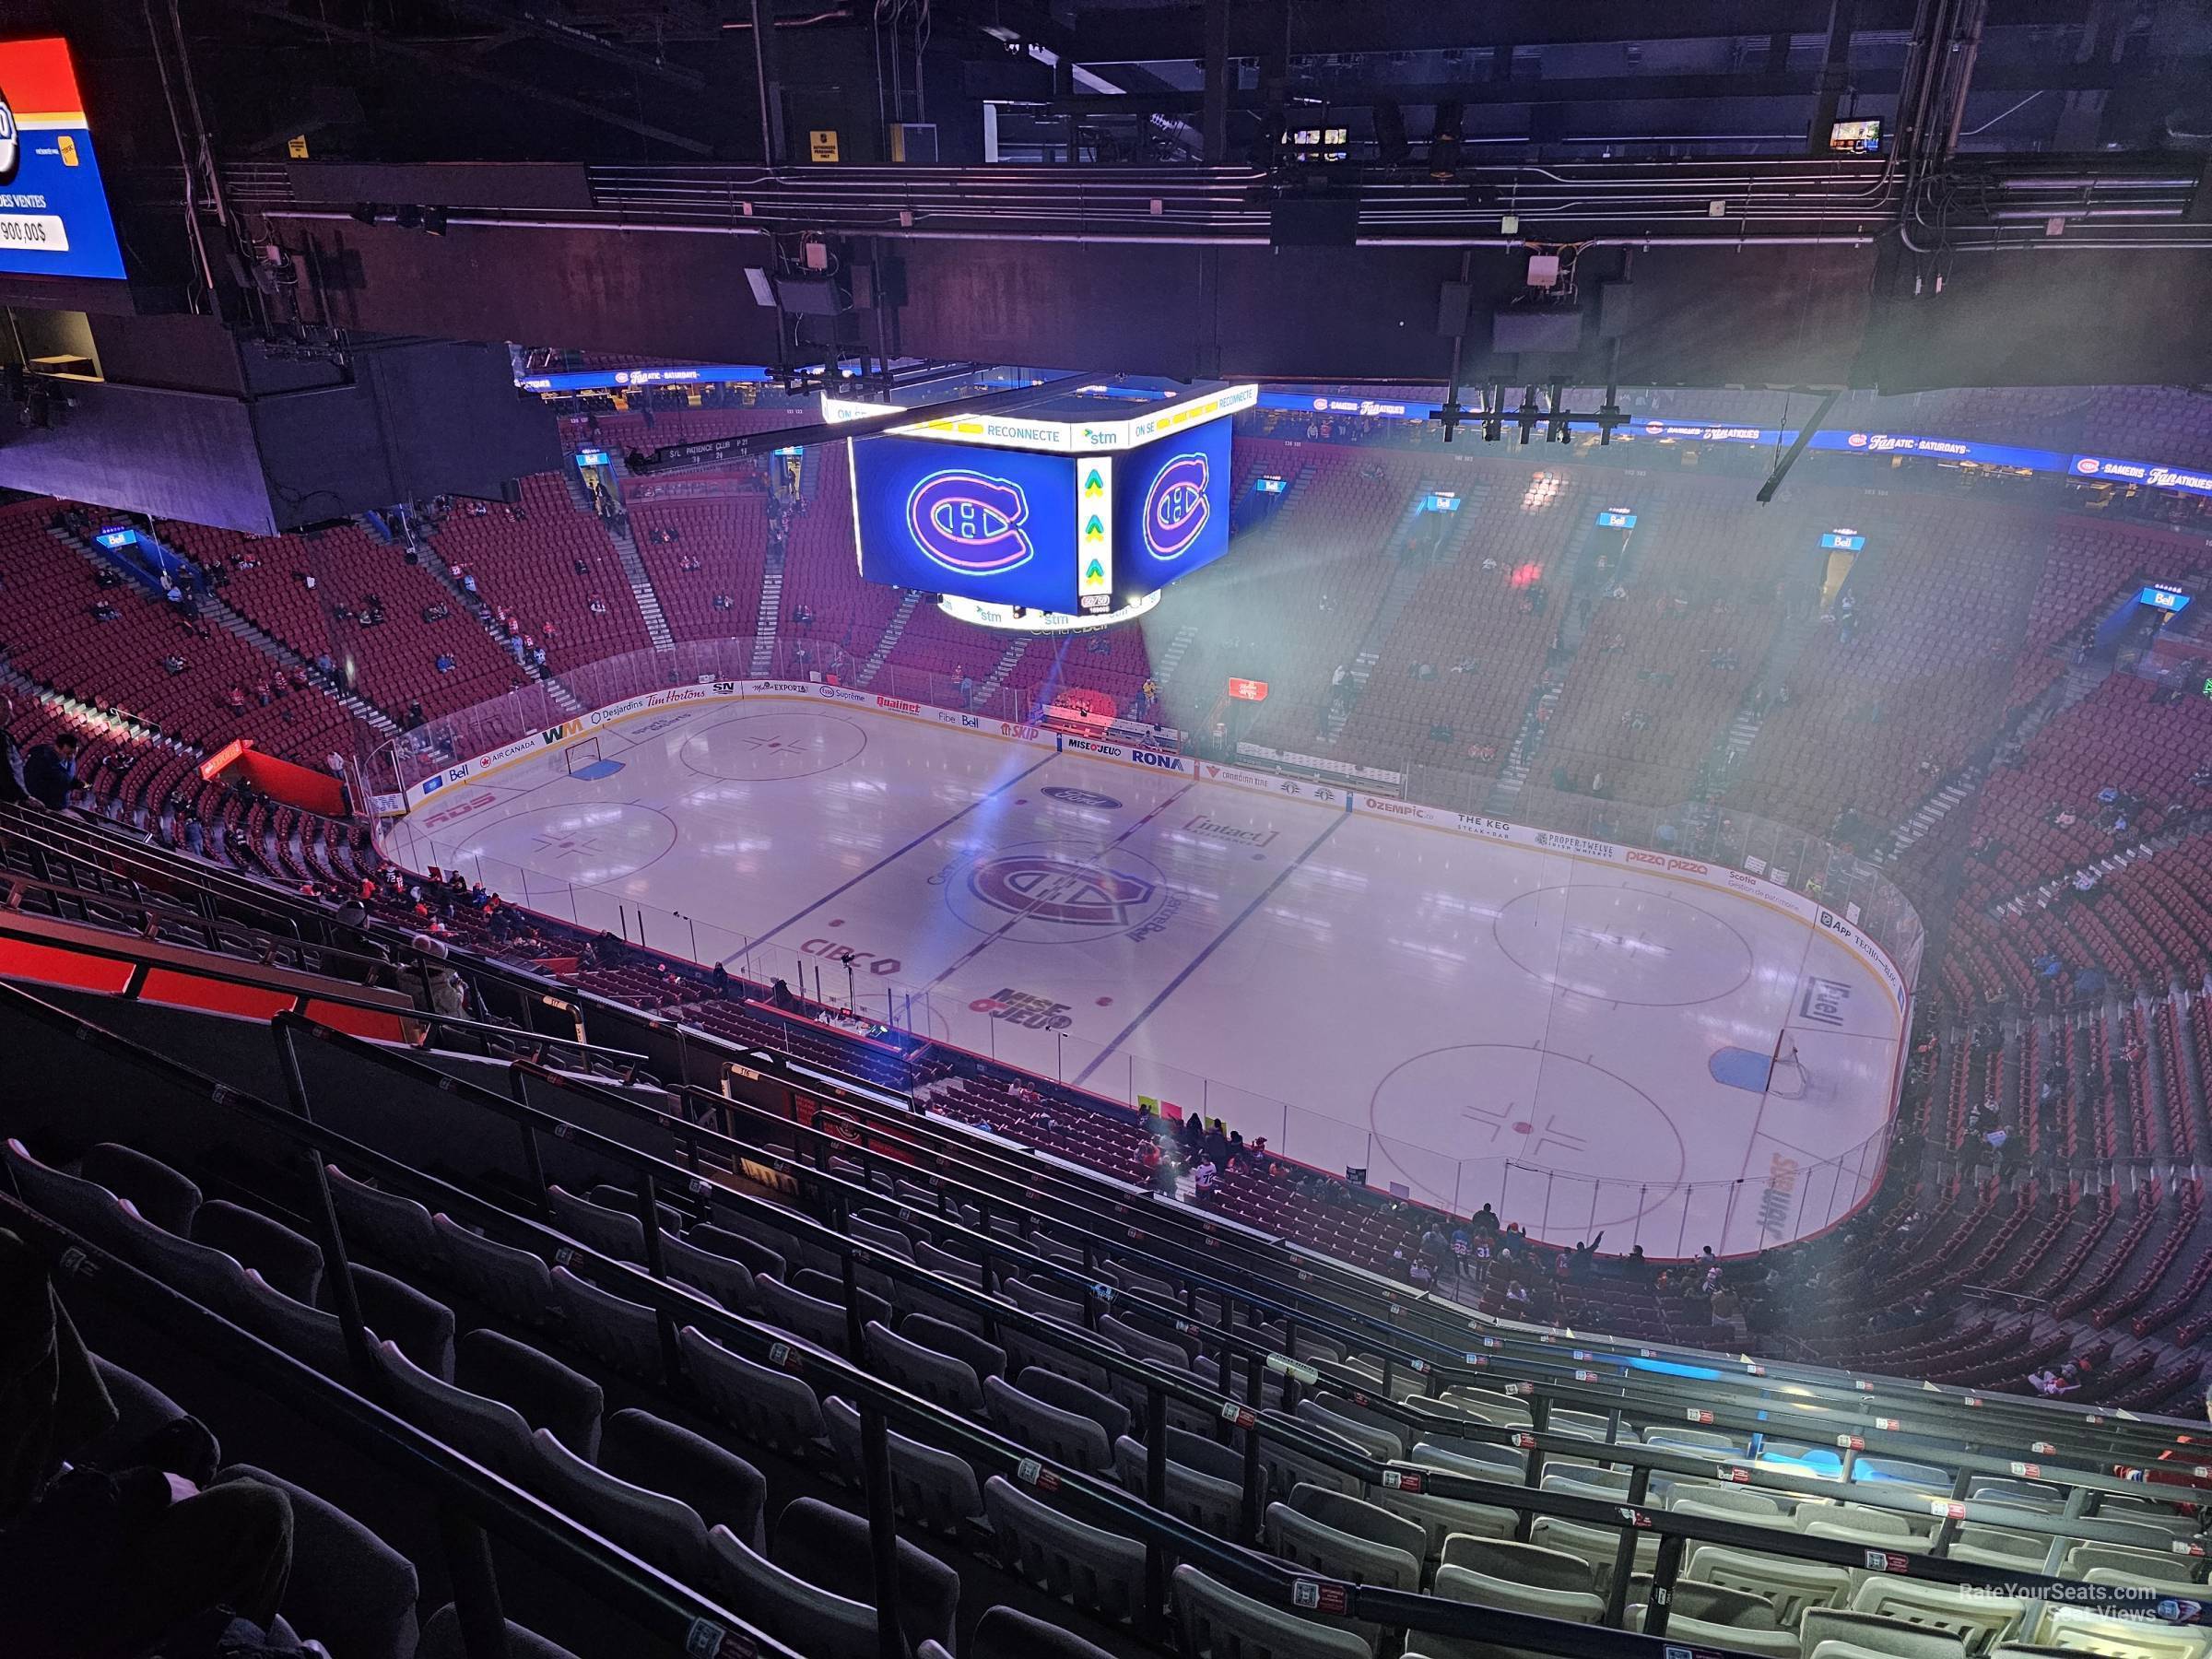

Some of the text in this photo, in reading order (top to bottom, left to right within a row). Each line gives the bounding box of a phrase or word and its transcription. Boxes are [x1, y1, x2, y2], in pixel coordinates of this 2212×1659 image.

[13, 194, 47, 208] VENTES
[0, 221, 46, 243] 900,00$
[1218, 389, 1253, 408] RECONNECTE
[987, 425, 1060, 442] RECONNECTE
[1090, 432, 1117, 444] stm
[1135, 421, 1155, 438] ON SE
[686, 443, 713, 454] PATIENCE
[1918, 441, 1967, 454] SATURDAYS
[2103, 464, 2145, 477] SAMEDIS
[1610, 516, 1626, 525] Bell
[109, 534, 125, 545] Bell
[1834, 536, 1852, 547] Bell
[2154, 593, 2175, 606] Bell
[981, 608, 1002, 623] stm
[712, 682, 735, 692] SN
[645, 689, 706, 708] Tim Hortons
[877, 695, 921, 714] Qualinet
[602, 699, 643, 719] Desjardins
[938, 712, 956, 724] Fibe
[961, 714, 979, 729] Bell
[541, 717, 583, 745] WM
[1013, 724, 1040, 741] SKIP
[491, 739, 535, 762] AIR CANADA
[1132, 749, 1184, 772] RONA
[449, 764, 470, 782] Bell
[1054, 790, 1107, 806] Ford
[1199, 819, 1262, 843] intact
[1457, 814, 1511, 831] THE KEG
[1548, 833, 1614, 854] PROPER TWELVE
[1625, 850, 1708, 877] pizza pizza
[1729, 870, 1757, 886] Scotia
[1727, 879, 1755, 895] Gestion
[1755, 888, 1764, 897] de
[800, 938, 875, 968] CIBC
[1477, 1246, 1490, 1258] 31
